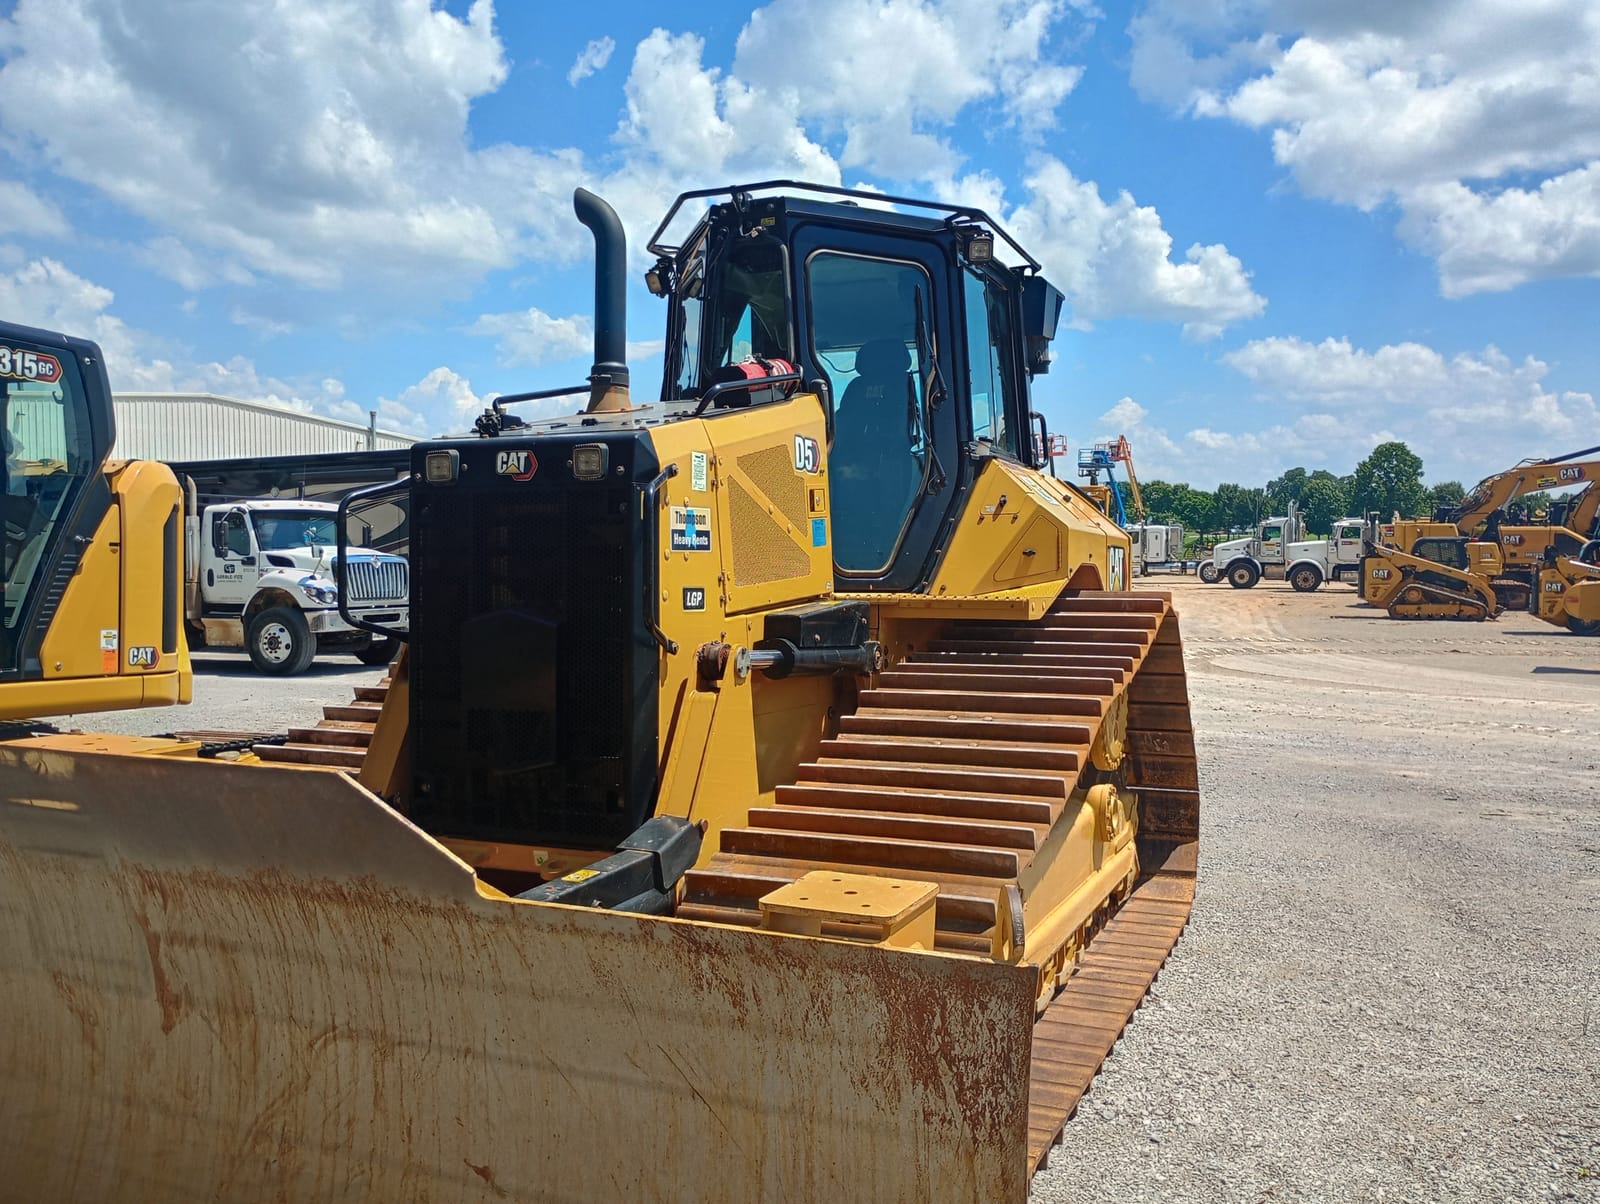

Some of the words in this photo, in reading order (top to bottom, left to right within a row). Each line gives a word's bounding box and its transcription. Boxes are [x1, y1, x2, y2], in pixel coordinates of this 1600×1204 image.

[0, 348, 38, 378] 315
[38, 361, 54, 376] GC
[795, 436, 813, 471] D5
[497, 451, 528, 474] CAT
[1560, 467, 1579, 480] CAT
[675, 510, 706, 526] Thompson
[673, 533, 691, 548] Heavy
[691, 533, 709, 549] Rents
[1503, 535, 1521, 545] CAT
[1372, 569, 1389, 578] CAT
[1545, 583, 1562, 592] CAT
[686, 591, 703, 606] LGP
[129, 647, 154, 665] CAT
